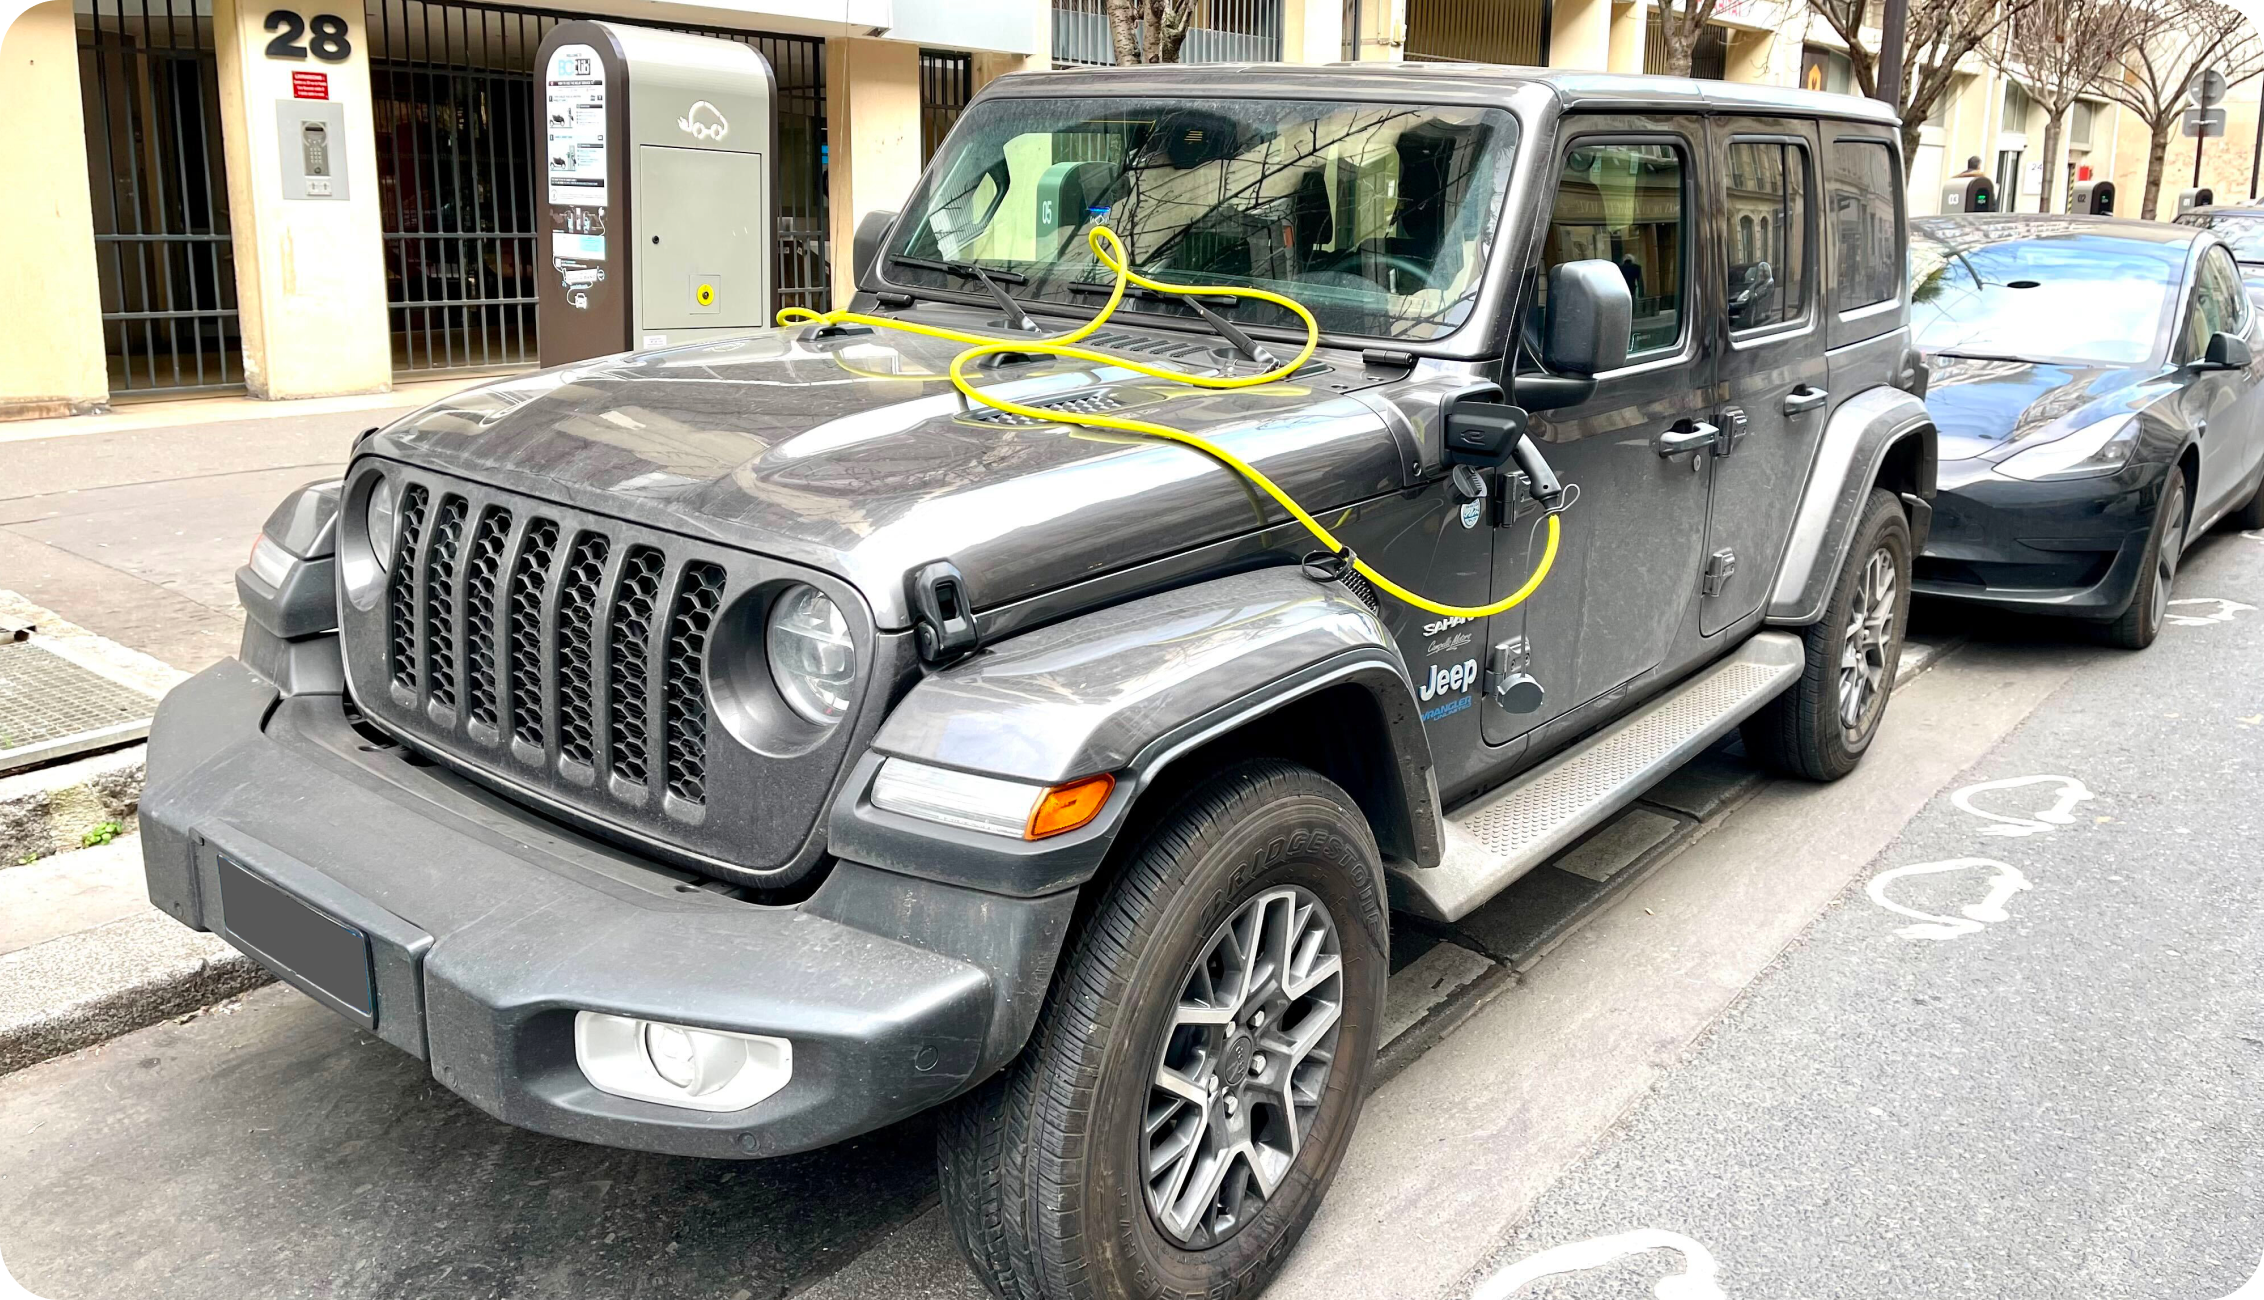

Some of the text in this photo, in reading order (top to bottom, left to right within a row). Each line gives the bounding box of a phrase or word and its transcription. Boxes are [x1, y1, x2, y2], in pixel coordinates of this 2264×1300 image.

[263, 10, 351, 61] 28
[1042, 200, 1052, 224] 05
[2077, 193, 2087, 203] 02
[1419, 658, 1478, 702] Jeep
